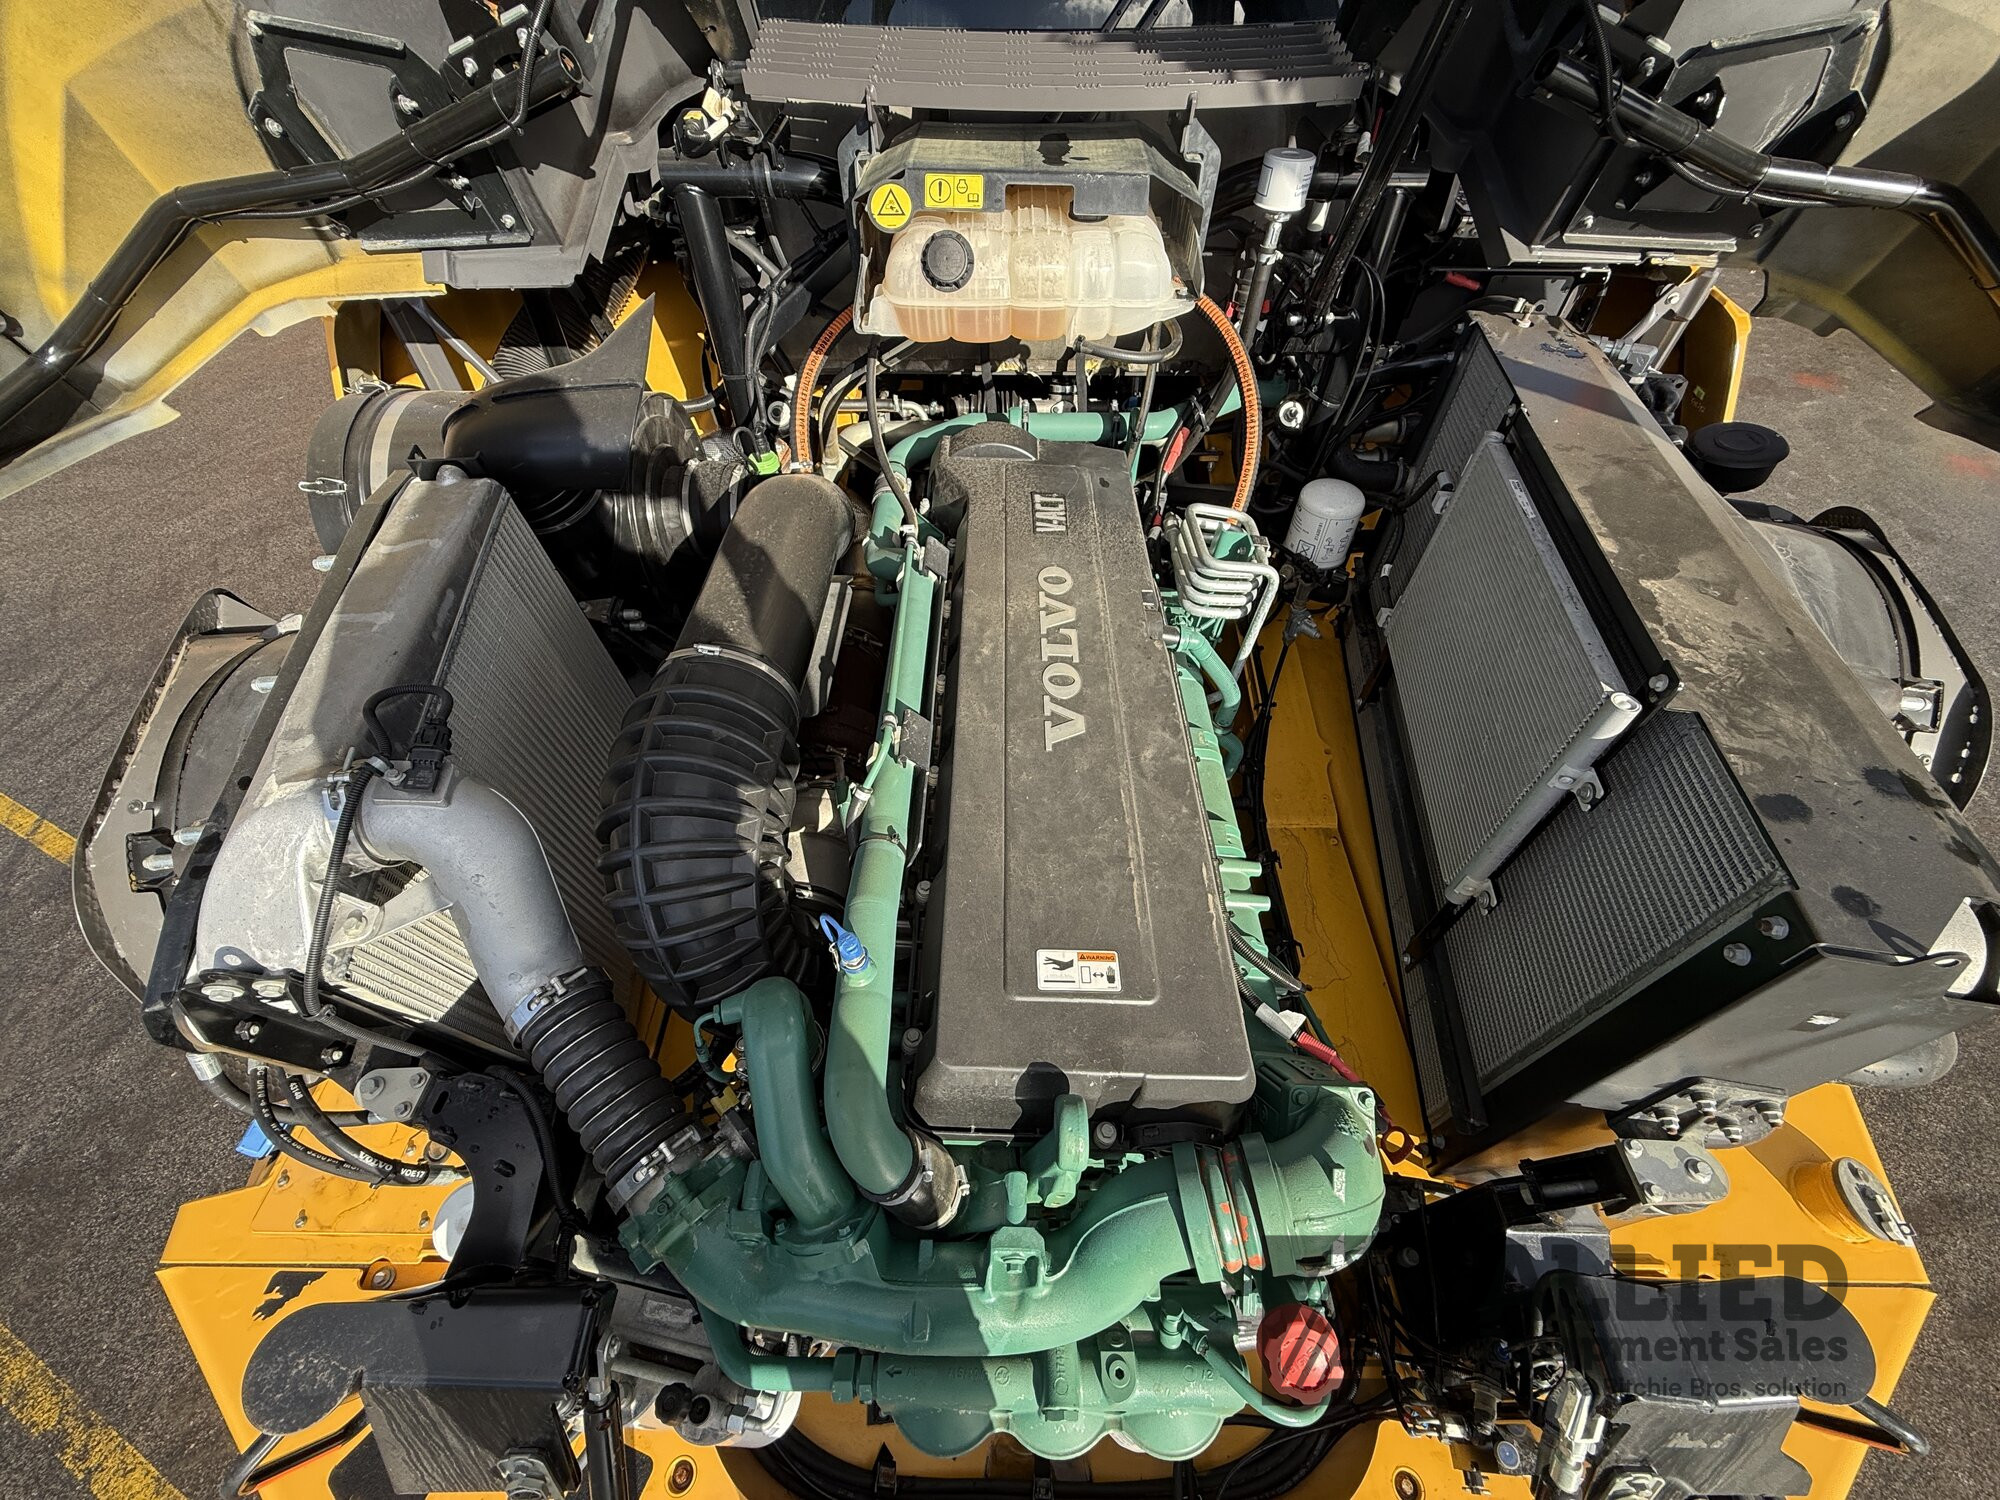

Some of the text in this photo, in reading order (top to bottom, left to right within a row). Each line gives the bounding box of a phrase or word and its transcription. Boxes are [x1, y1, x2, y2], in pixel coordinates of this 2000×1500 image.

[1233, 468, 1250, 510] DROSCAND
[1246, 425, 1256, 467] MULTIFLEX
[1038, 566, 1086, 751] VOLVO
[358, 1151, 393, 1171] VOLVO
